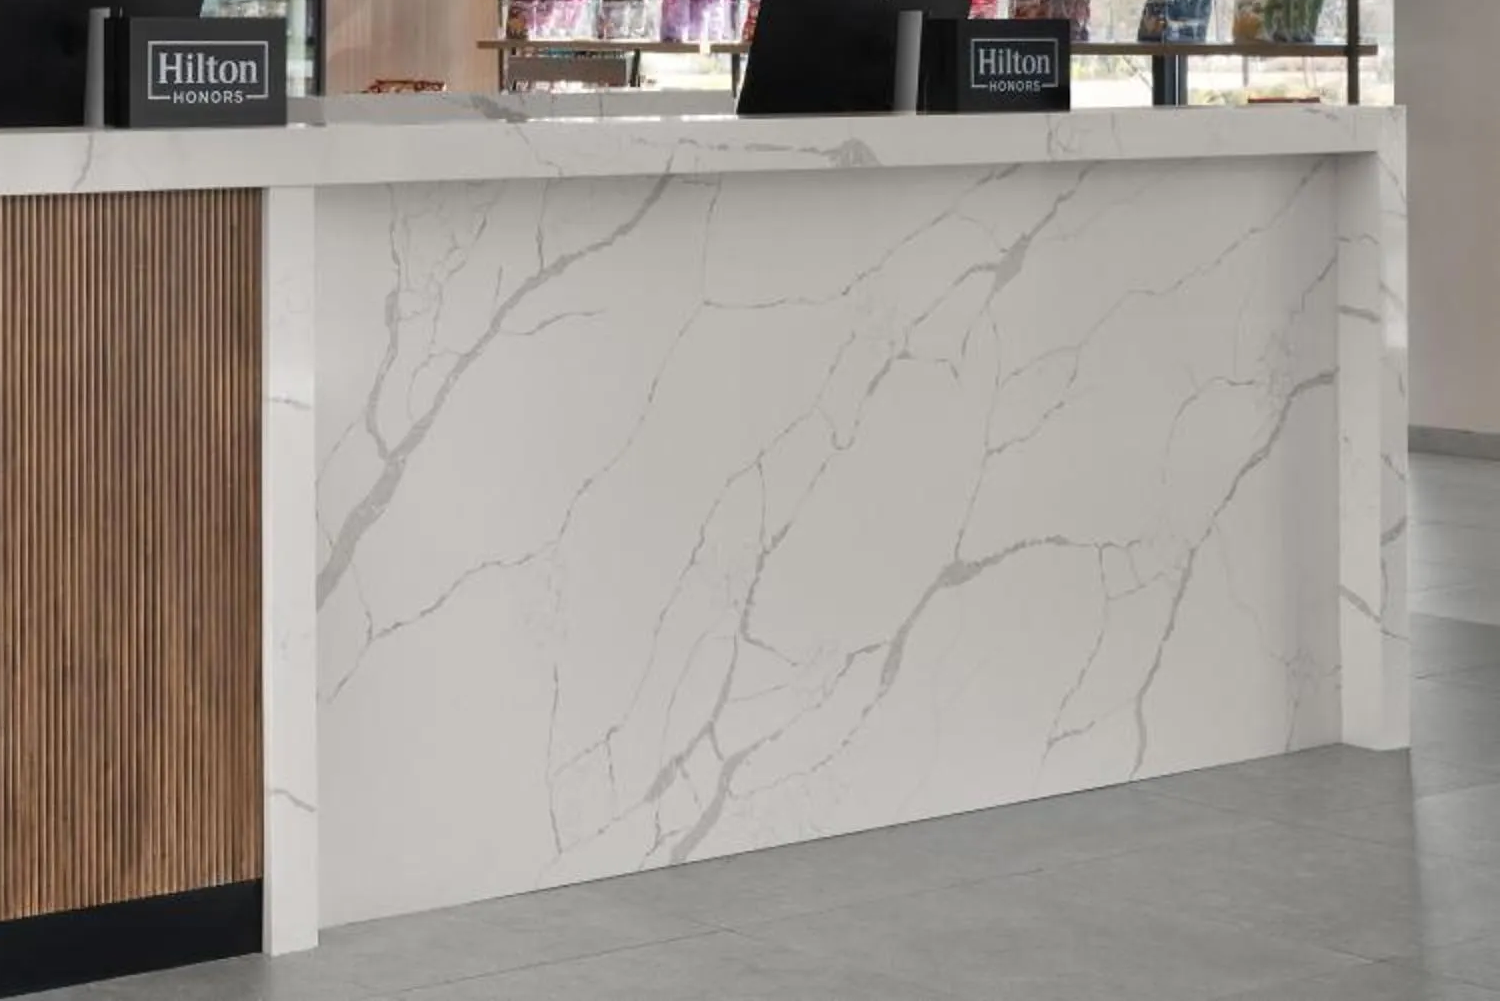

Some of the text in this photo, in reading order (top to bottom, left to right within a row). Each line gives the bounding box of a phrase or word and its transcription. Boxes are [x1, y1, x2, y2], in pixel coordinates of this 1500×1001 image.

[158, 52, 260, 84] Hilton
[978, 48, 1051, 76] Hilton
[173, 90, 244, 104] HONORS
[989, 80, 1041, 93] HONORS
